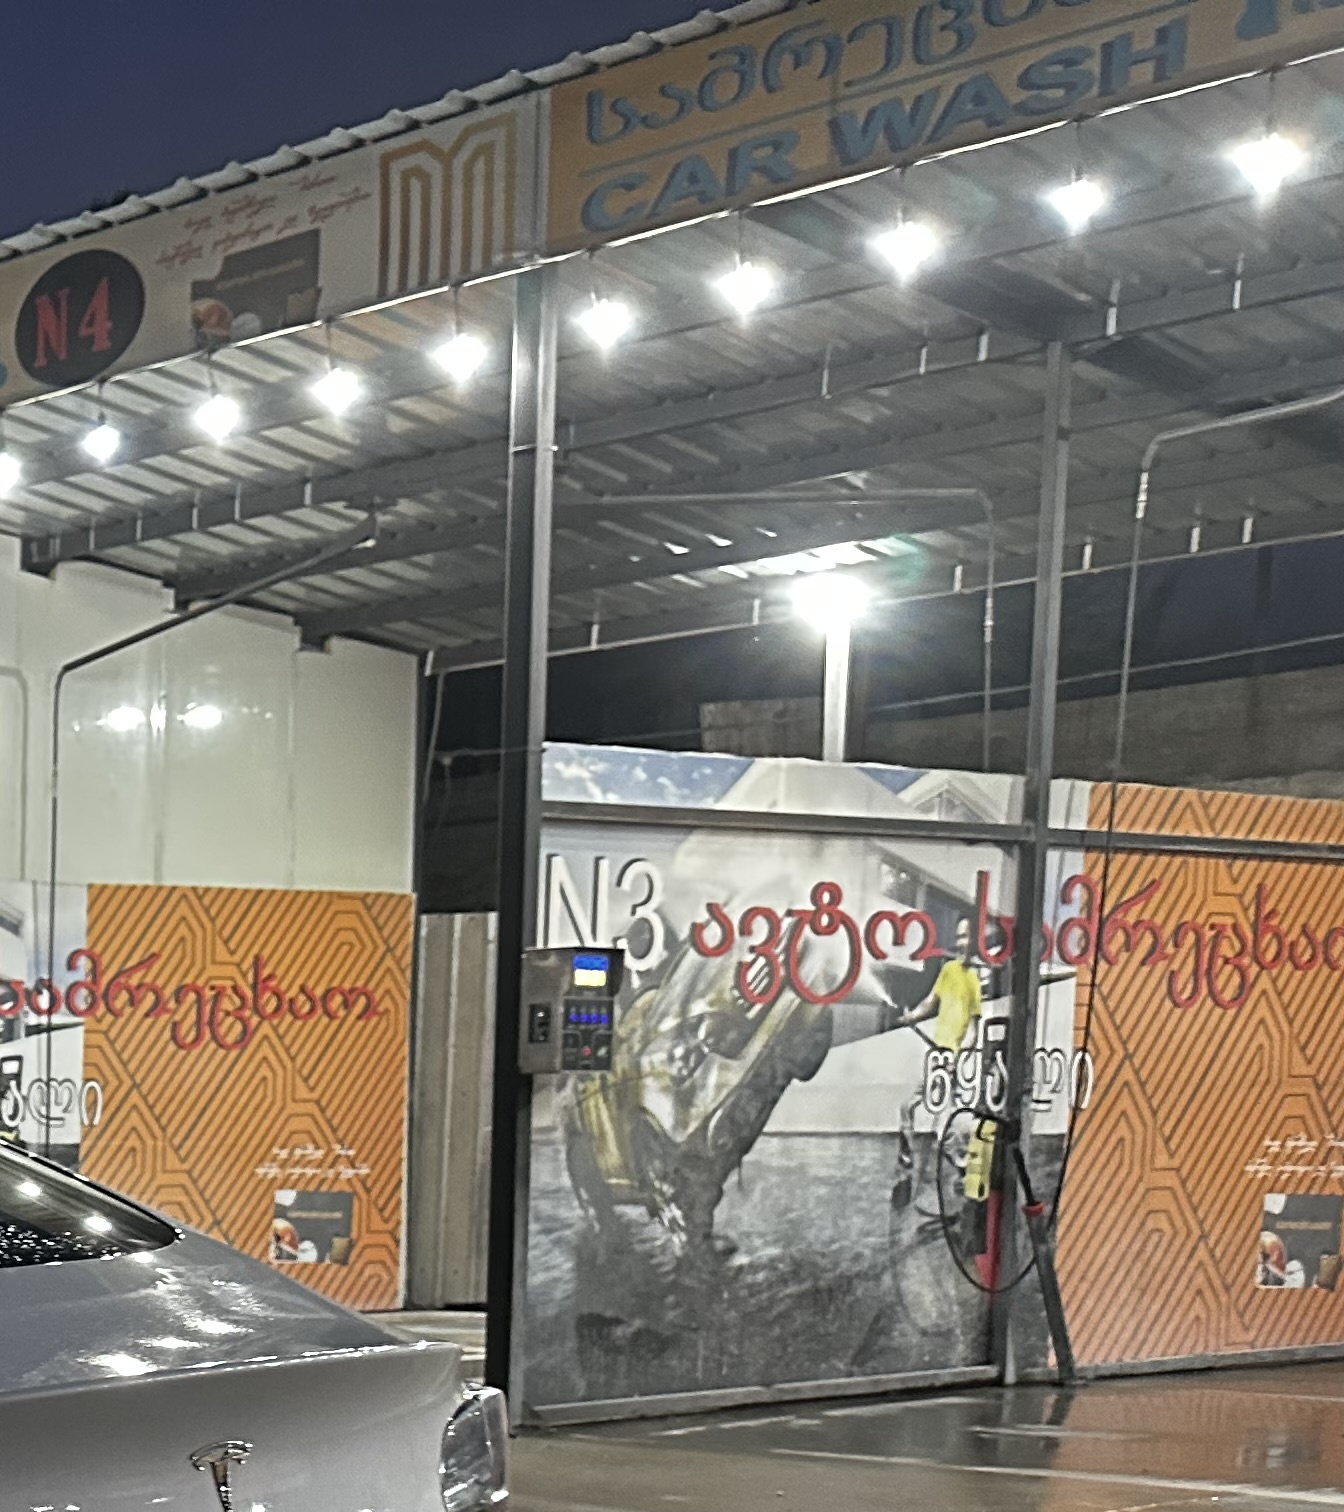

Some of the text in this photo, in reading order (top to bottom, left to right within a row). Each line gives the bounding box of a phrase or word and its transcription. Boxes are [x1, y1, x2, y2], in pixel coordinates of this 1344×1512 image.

[581, 14, 1189, 232] CAR WASH
[587, 0, 1092, 144] სამრეც
[546, 853, 665, 972] N3
[691, 881, 944, 1005] ავტო
